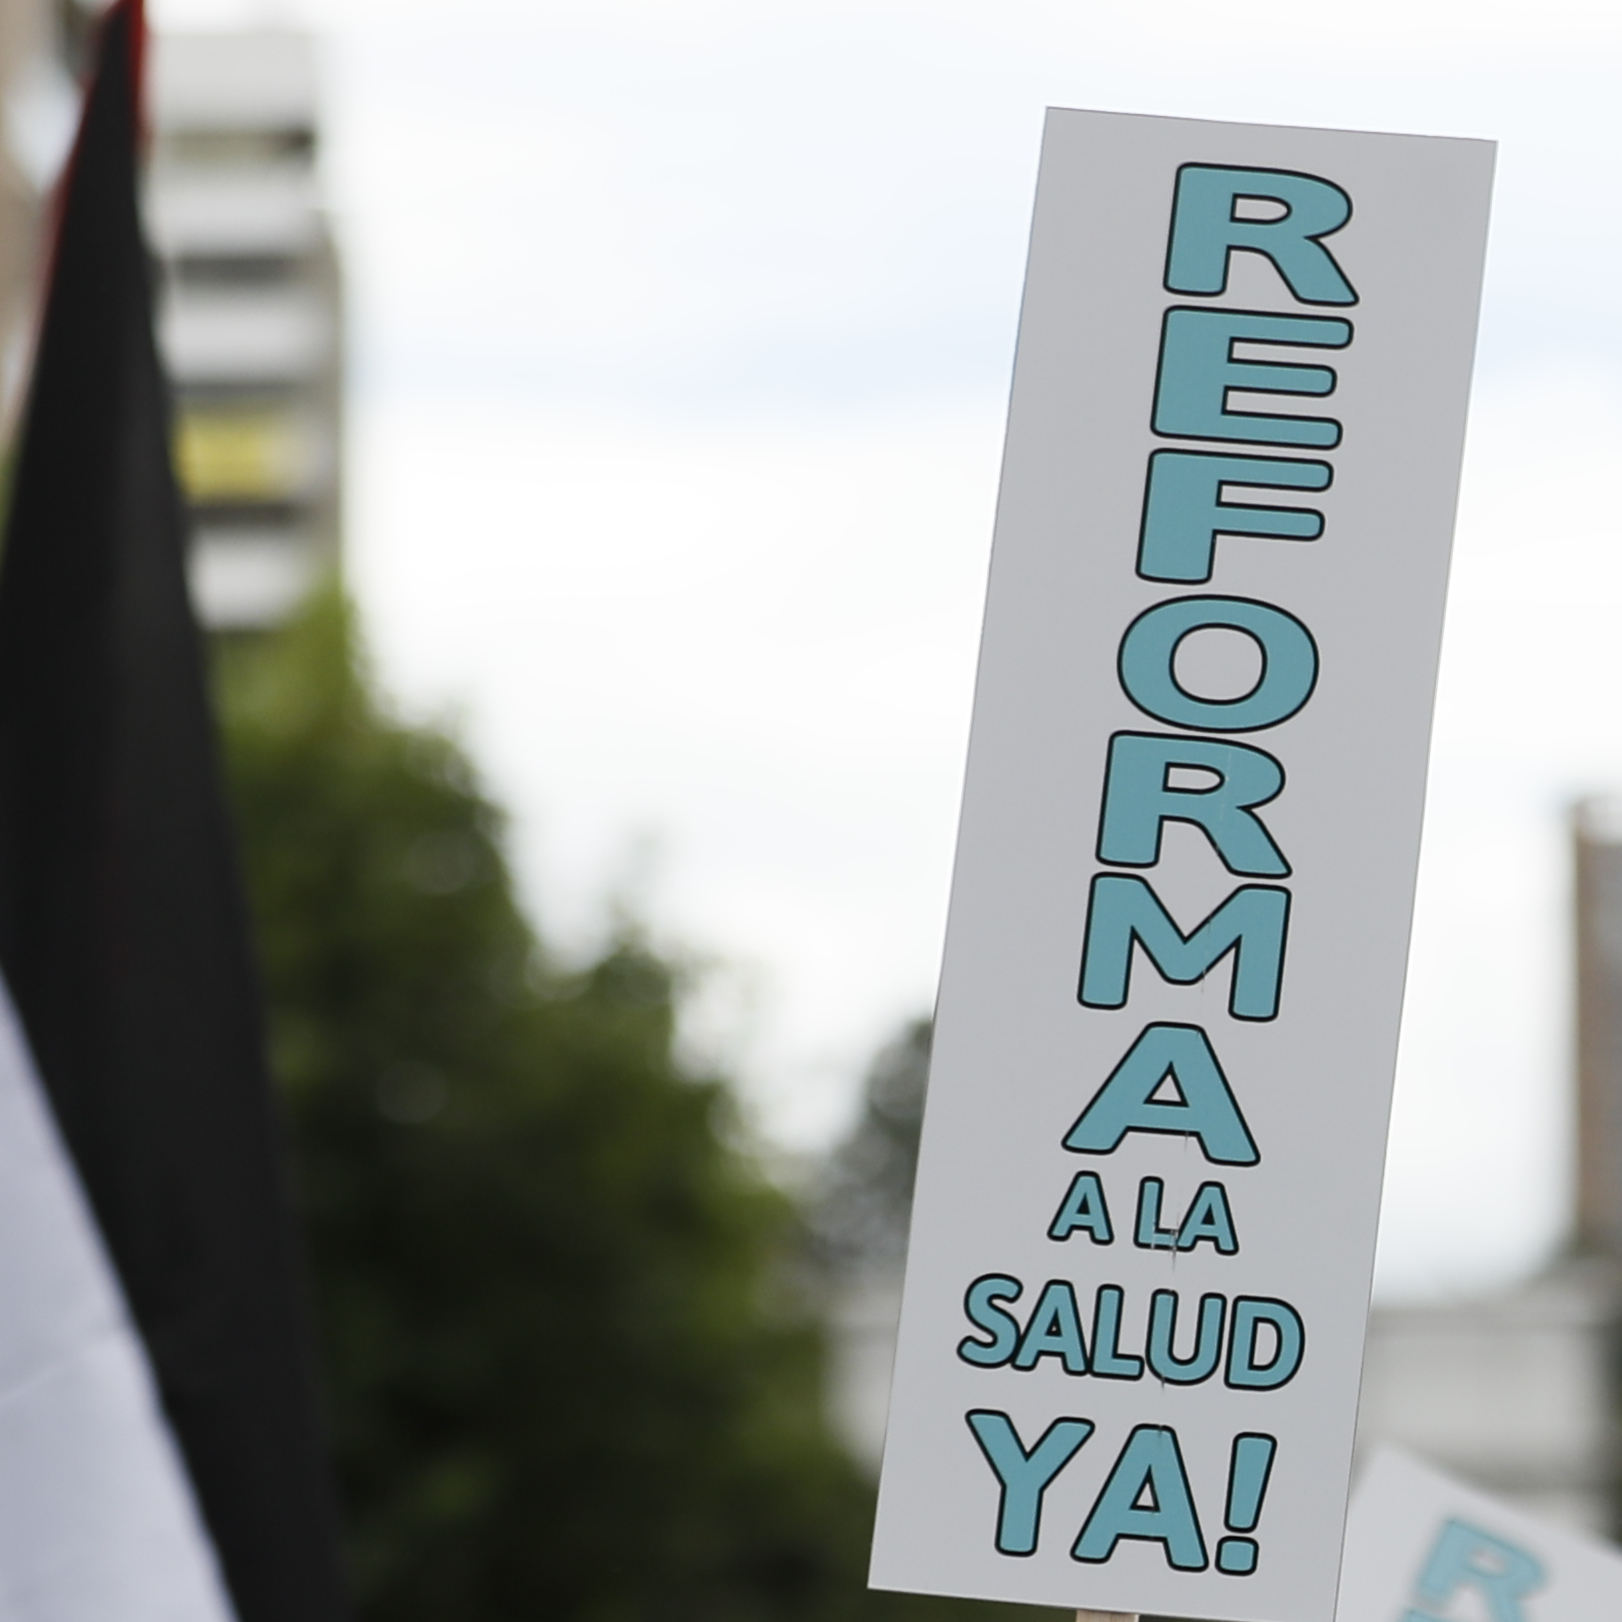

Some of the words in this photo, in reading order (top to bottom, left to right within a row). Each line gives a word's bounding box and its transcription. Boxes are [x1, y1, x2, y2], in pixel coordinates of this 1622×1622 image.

[1061, 161, 1360, 1167] REFORMA
[1047, 1170, 1114, 1245] A
[1133, 1176, 1240, 1256] LA
[956, 1272, 1307, 1392] SALUD
[965, 1408, 1278, 1577] YA!
